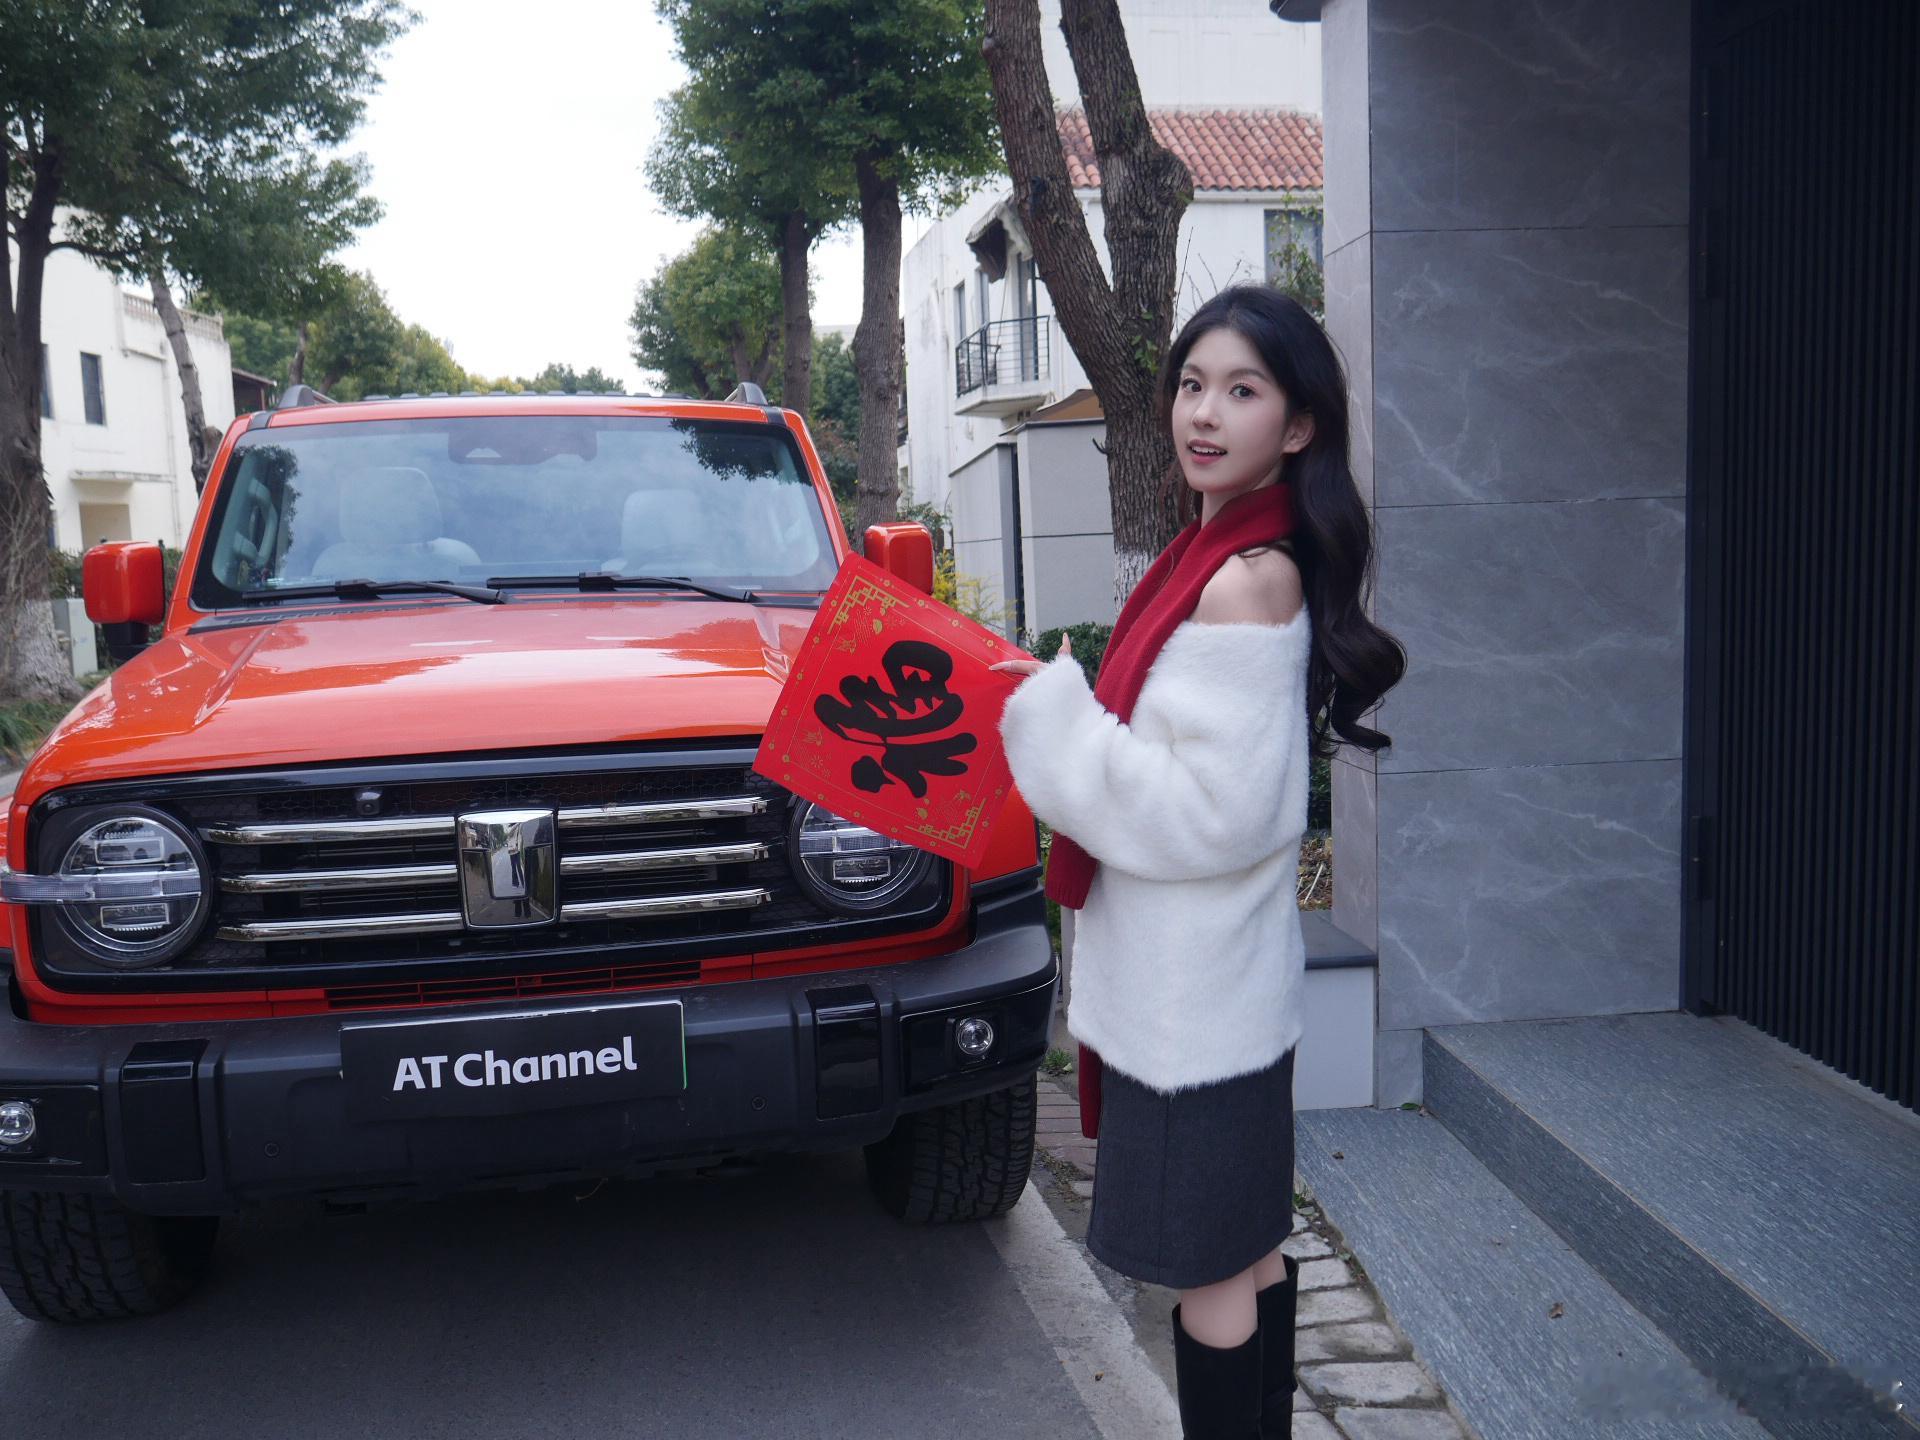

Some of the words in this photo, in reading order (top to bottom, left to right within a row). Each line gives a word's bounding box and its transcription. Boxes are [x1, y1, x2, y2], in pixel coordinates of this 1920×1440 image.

[814, 640, 977, 798] 福
[393, 1055, 447, 1091] AT
[454, 1036, 637, 1086] Channel
